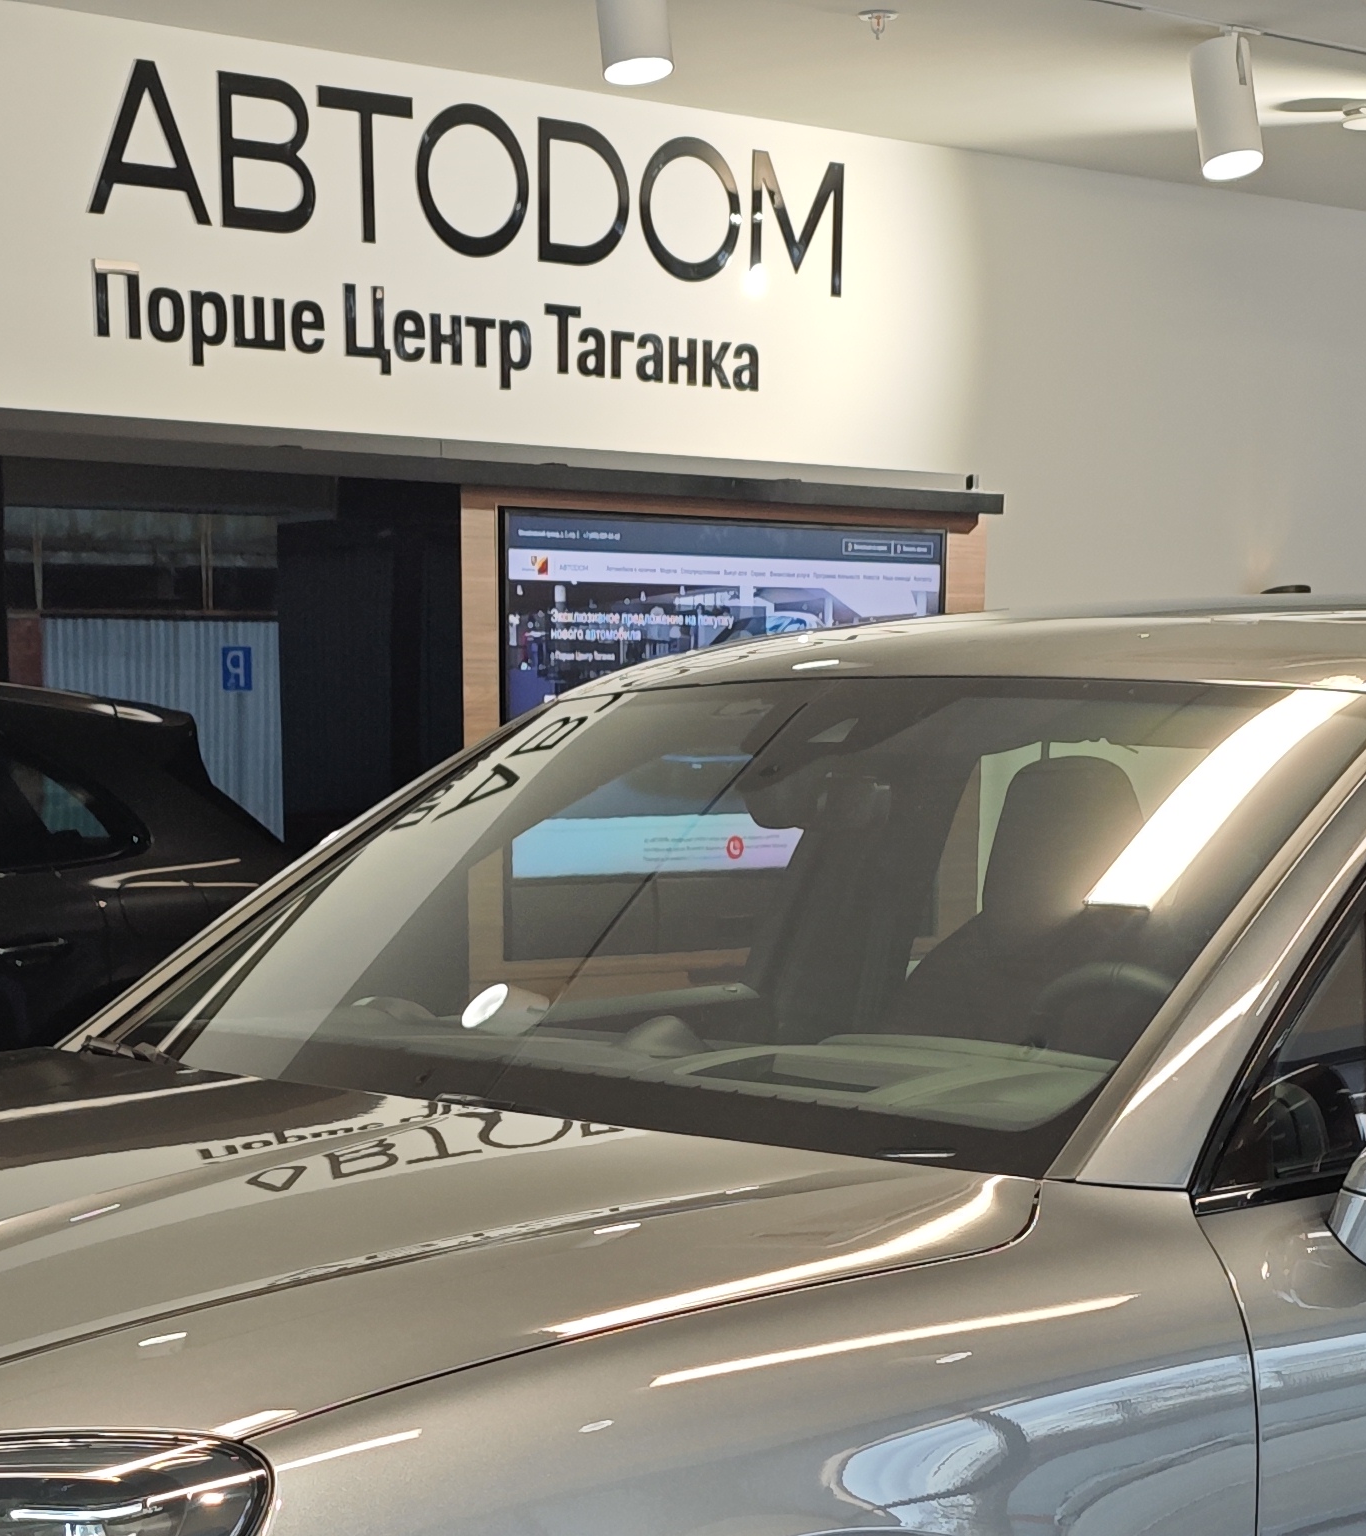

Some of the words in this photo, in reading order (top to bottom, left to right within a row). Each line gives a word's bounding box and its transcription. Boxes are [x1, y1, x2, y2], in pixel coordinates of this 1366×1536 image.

[92, 258, 325, 366] Порше
[344, 283, 532, 390] Центр
[544, 303, 760, 392] Таганка
